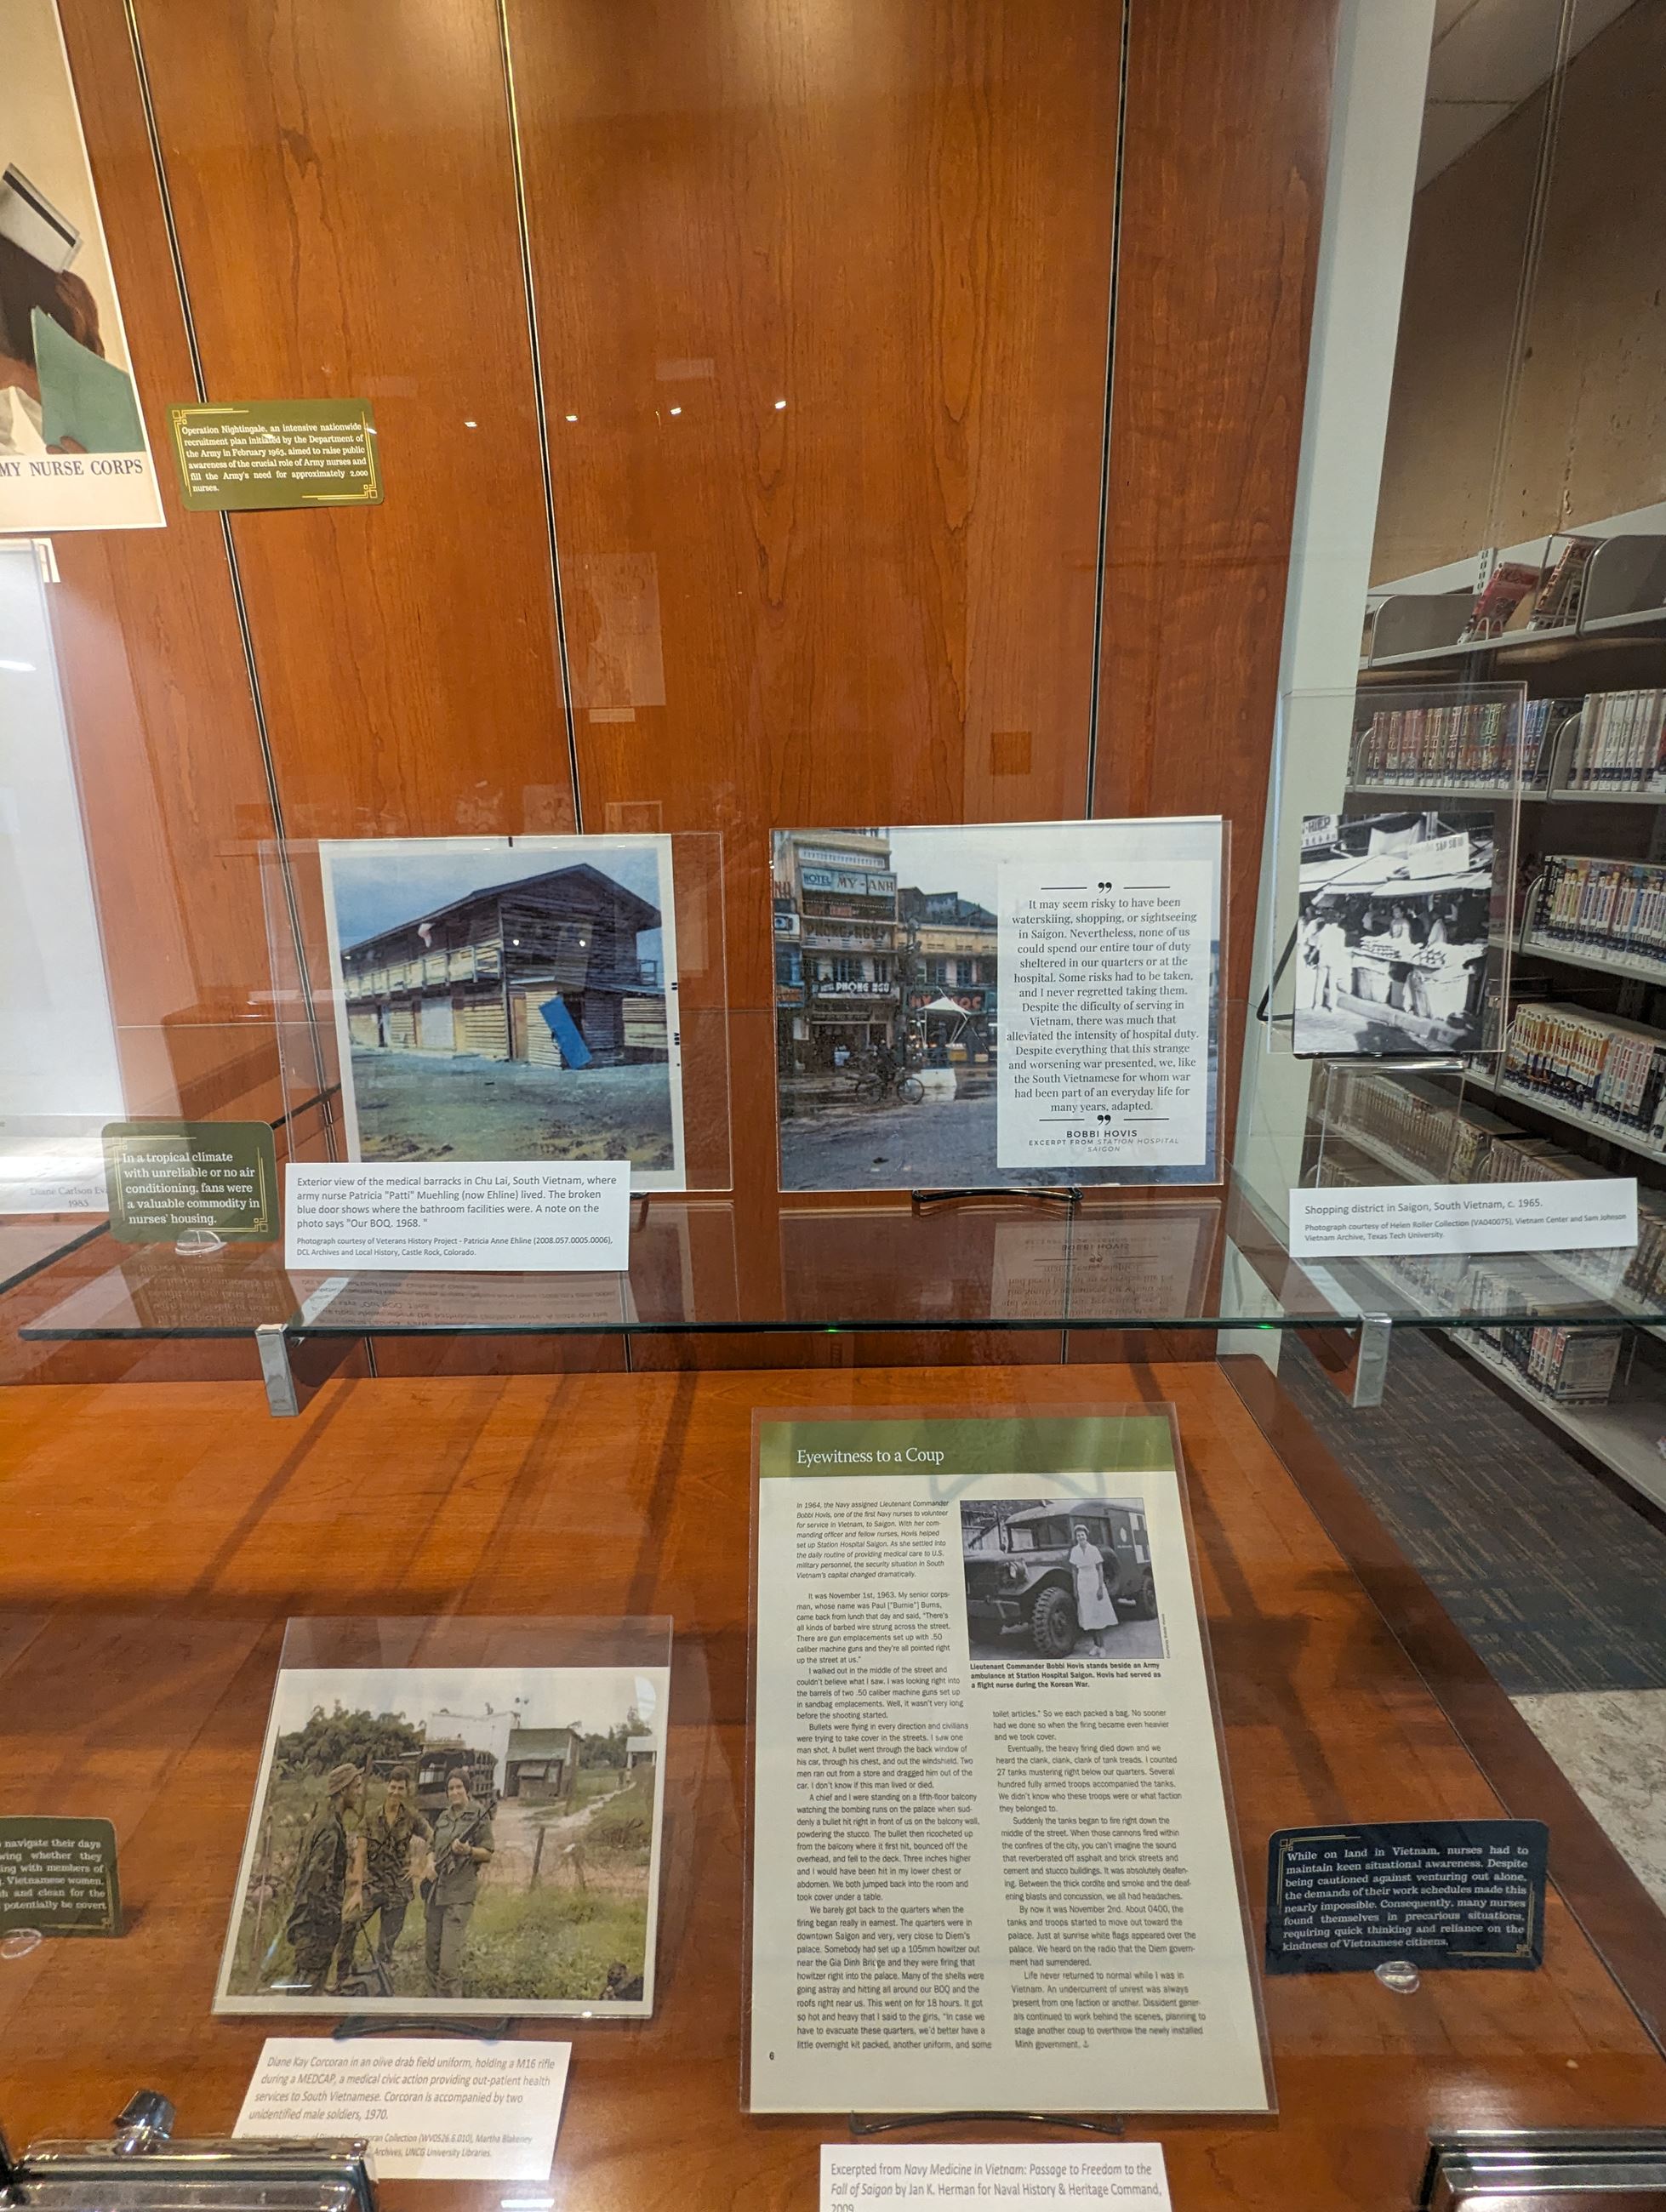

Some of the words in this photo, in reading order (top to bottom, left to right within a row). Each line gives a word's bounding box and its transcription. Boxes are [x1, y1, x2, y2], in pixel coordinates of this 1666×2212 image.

[181, 426, 219, 436] Operation
[282, 424, 317, 432] intensive
[320, 422, 361, 431] nationwide
[230, 437, 247, 446] plan
[248, 436, 281, 444] initiated
[282, 436, 292, 445] by
[294, 435, 307, 443] the
[308, 435, 354, 444] Department
[29, 460, 84, 476] NURSE
[90, 459, 143, 475] CORPS
[223, 471, 249, 481] Army's
[253, 470, 272, 479] need
[276, 470, 288, 478] for
[291, 470, 345, 479] approximately
[1040, 902, 1059, 910] may
[1092, 898, 1115, 909] risky
[1119, 899, 1128, 908] to
[1132, 898, 1154, 907] have
[1157, 898, 1180, 907] been
[1012, 914, 1073, 925] waterskiing,
[1075, 913, 1124, 924] shopping,
[1141, 912, 1197, 923] sightseeing
[123, 1153, 134, 1163] In
[146, 1153, 191, 1164] tropical
[191, 1153, 233, 1162] climate
[124, 1168, 150, 1177] with
[151, 1167, 208, 1177] unreliable
[239, 1167, 255, 1177] air
[298, 1177, 332, 1186] Exterior
[334, 1177, 355, 1186] view
[357, 1177, 367, 1186] of
[368, 1177, 384, 1186] the
[386, 1177, 421, 1185] medical
[424, 1177, 461, 1185] barracks
[464, 1177, 472, 1185] in
[475, 1176, 492, 1185] Chu
[495, 1176, 510, 1186] Lai,
[513, 1176, 539, 1185] South
[542, 1176, 584, 1185] Vietnam,
[587, 1176, 616, 1184] where
[201, 1183, 225, 1193] fans
[136, 1199, 185, 1208] valuable
[186, 1199, 247, 1210] commodity
[248, 1199, 260, 1208] in
[1305, 1206, 1349, 1215] Shopping
[1351, 1204, 1384, 1213] district
[1398, 1203, 1431, 1213] Saigon,
[1434, 1201, 1461, 1211] South
[1519, 1198, 1543, 1207] 1965.
[129, 1214, 168, 1224] nurses'
[171, 1214, 217, 1225] housing.
[797, 1450, 873, 1467] Eyewitness
[876, 1450, 891, 1462] to
[905, 1447, 944, 1465] Coup
[977, 1681, 994, 1690] flight
[4, 1839, 48, 1849] navigate
[51, 1839, 75, 1847] their
[77, 1839, 101, 1850] days
[1287, 1849, 1317, 1861] While
[1344, 1849, 1367, 1857] land
[1375, 1848, 1384, 1856] in
[1490, 1845, 1509, 1855] had
[1517, 1846, 1529, 1855] to
[1015, 2039, 1033, 2048] Minh
[1036, 2041, 1080, 2050] government.
[248, 2108, 302, 2119] unidentified
[303, 2109, 325, 2119] male
[326, 2108, 362, 2120] soldiers,
[364, 2108, 388, 2120] 1970.
[831, 2164, 876, 2176] Excerpted
[879, 2163, 901, 2175] from
[904, 2164, 927, 2177] Navy
[930, 2164, 972, 2175] Medicine
[974, 2164, 983, 2175] in
[985, 2164, 1026, 2175] Vietnam:
[1030, 2164, 1066, 2177] Passage
[1070, 2165, 1079, 2175] to
[1081, 2164, 1121, 2175] Freedom
[1124, 2164, 1134, 2175] to
[1137, 2164, 1151, 2175] the
